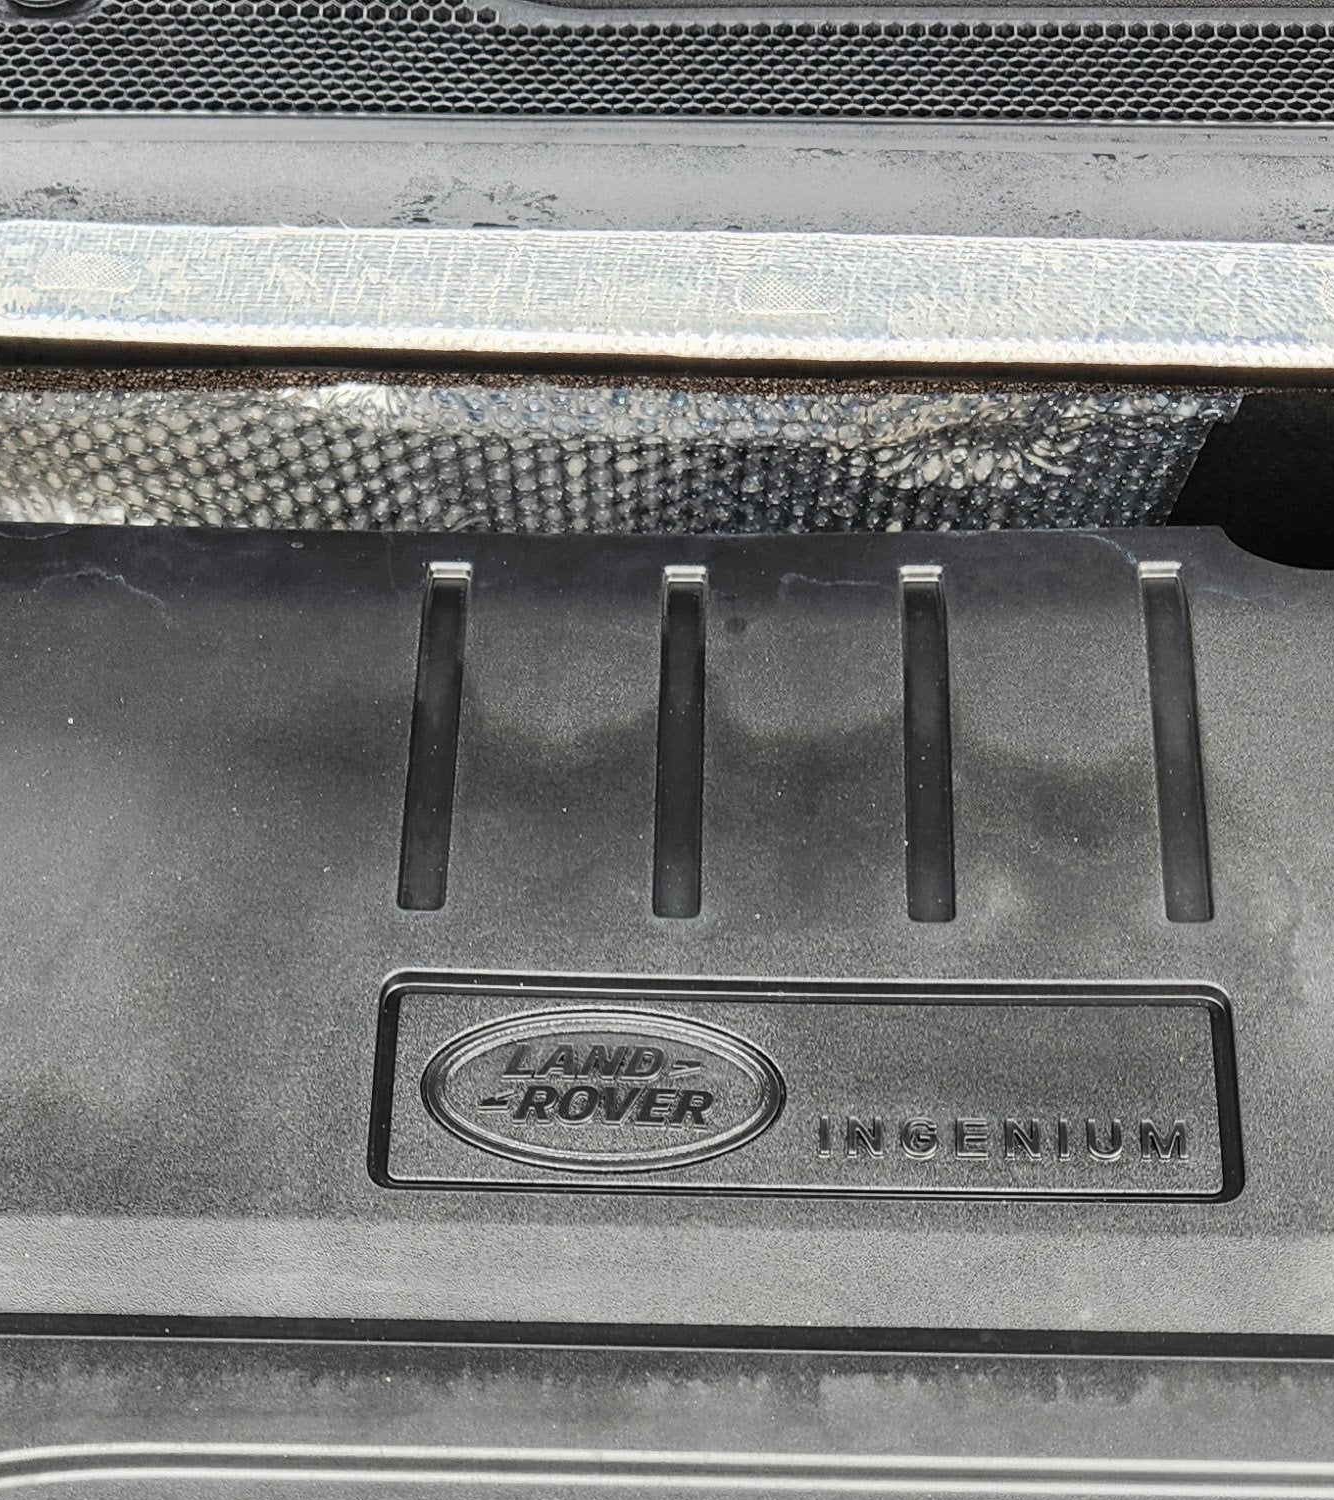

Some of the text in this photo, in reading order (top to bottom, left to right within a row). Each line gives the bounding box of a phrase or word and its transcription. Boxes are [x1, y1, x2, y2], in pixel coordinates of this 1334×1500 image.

[500, 1043, 665, 1082] LAND
[513, 1084, 715, 1129] ROVER
[816, 1113, 1192, 1164] INGENIUM
